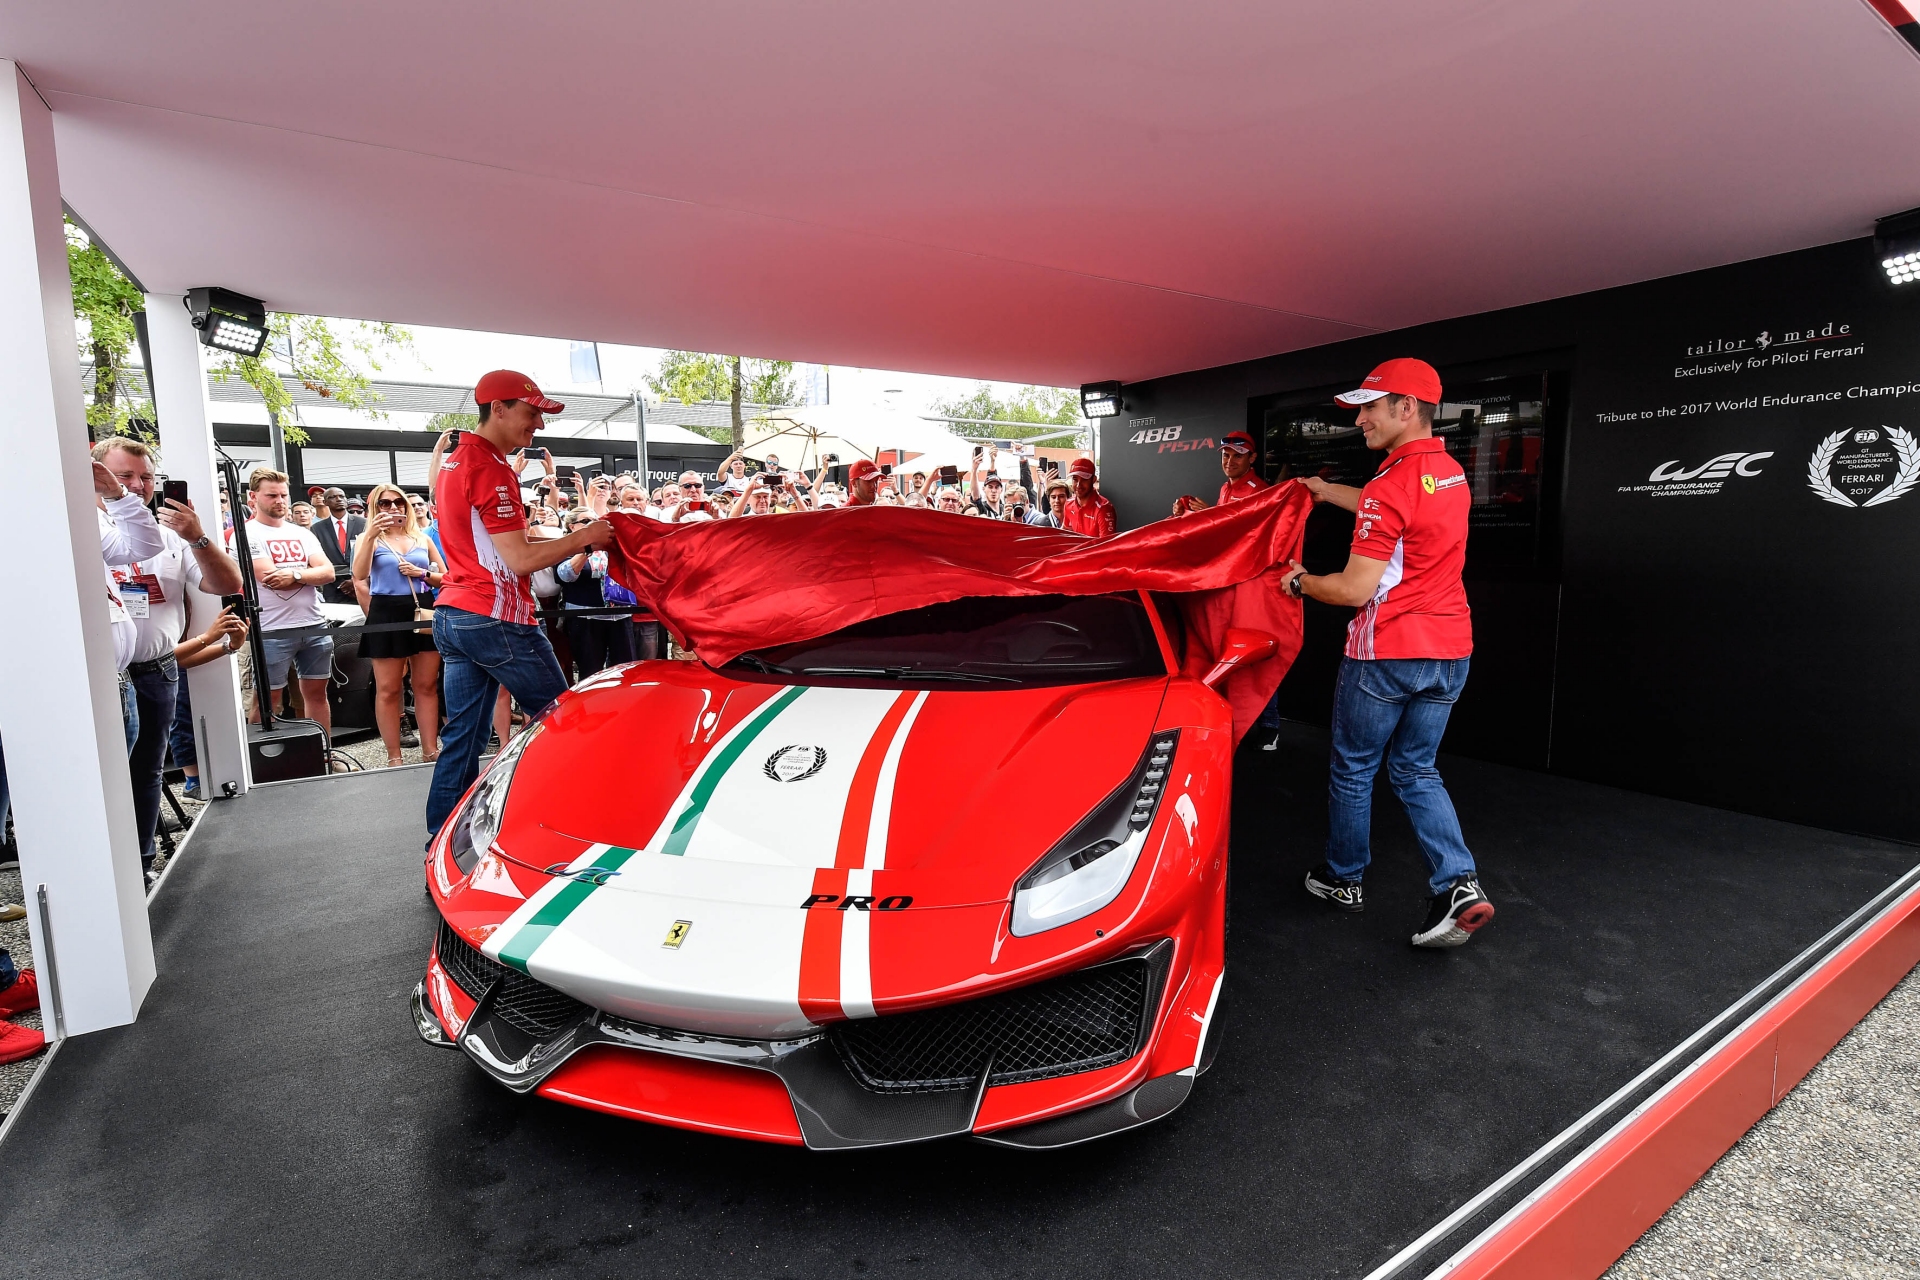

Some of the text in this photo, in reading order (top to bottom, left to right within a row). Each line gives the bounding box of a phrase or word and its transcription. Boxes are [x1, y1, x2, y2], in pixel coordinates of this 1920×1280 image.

[1687, 322, 1850, 356] tailor made
[1674, 343, 1865, 378] Exclusively for Piloti Ferrari
[1596, 412, 1638, 423] Tribute
[1641, 411, 1653, 420] to
[1657, 407, 1677, 418] the
[1680, 402, 1712, 415] 2017
[1715, 397, 1758, 411] World
[1763, 391, 1842, 407] Endurance
[1129, 416, 1156, 428] Ferrari
[1129, 425, 1183, 445] 488
[1855, 431, 1877, 441] FIA
[1157, 437, 1215, 454] PISTA
[1649, 451, 1775, 481] WEC
[1633, 484, 1663, 492] WORLD
[1664, 481, 1725, 490] ENDURANCE
[1841, 474, 1884, 484] FERRARI
[1651, 488, 1720, 497] CHAMPIONSHIP
[269, 541, 305, 563] 919
[800, 894, 914, 912] PRO
